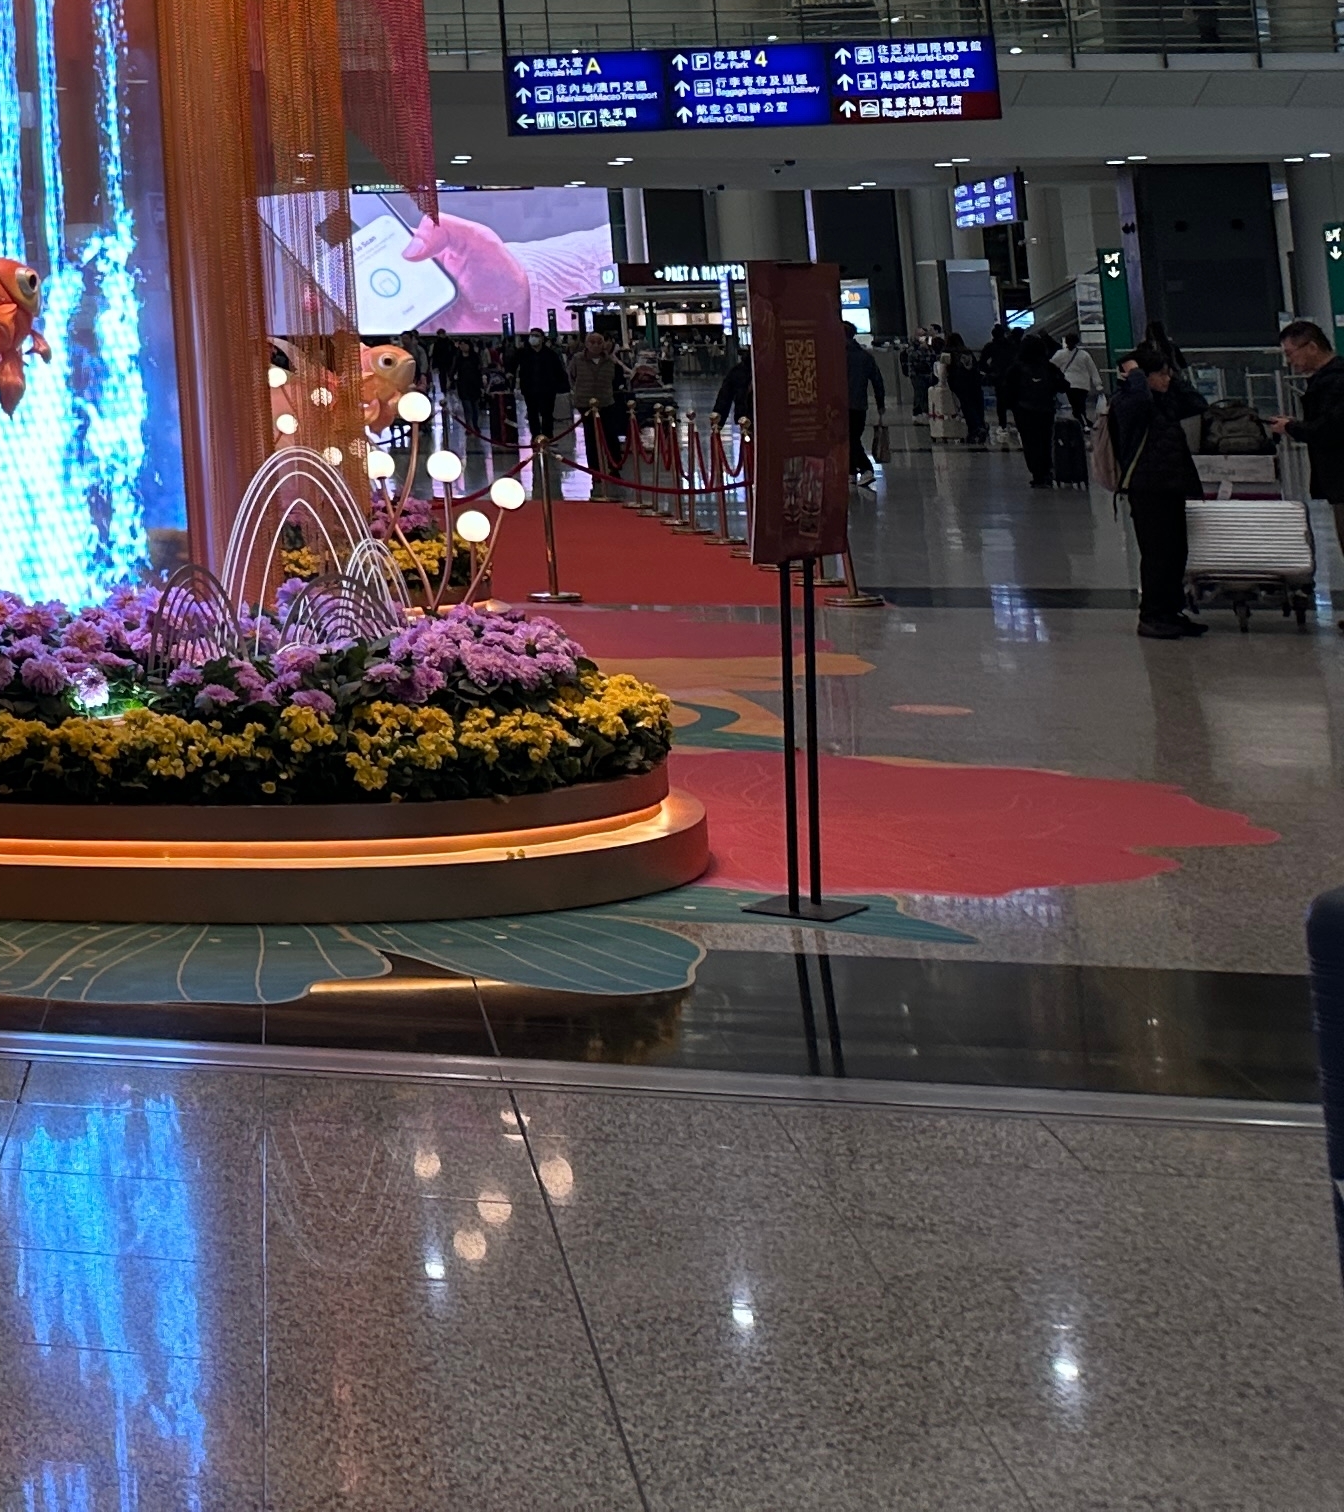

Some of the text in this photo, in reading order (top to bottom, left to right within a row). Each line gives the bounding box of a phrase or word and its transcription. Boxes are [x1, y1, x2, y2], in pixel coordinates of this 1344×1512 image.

[877, 40, 982, 55] 往亞洲國際博覽館
[713, 59, 750, 70] Car Park
[714, 49, 768, 68] 停車場 4
[878, 55, 889, 64] To
[533, 57, 602, 75] 接機大堂 A
[534, 67, 583, 78] Arrivals Hall
[881, 78, 970, 91] Airport Lost & Found
[620, 91, 658, 102] Transport
[715, 85, 820, 97] Baggage Storage and Delivery
[599, 107, 637, 119] 洗手間
[696, 113, 755, 124] Airline Offices
[882, 106, 963, 119] Regal Airport Hotel
[600, 118, 627, 128] Toilets
[663, 264, 690, 282] PRET
[691, 265, 700, 281] A
